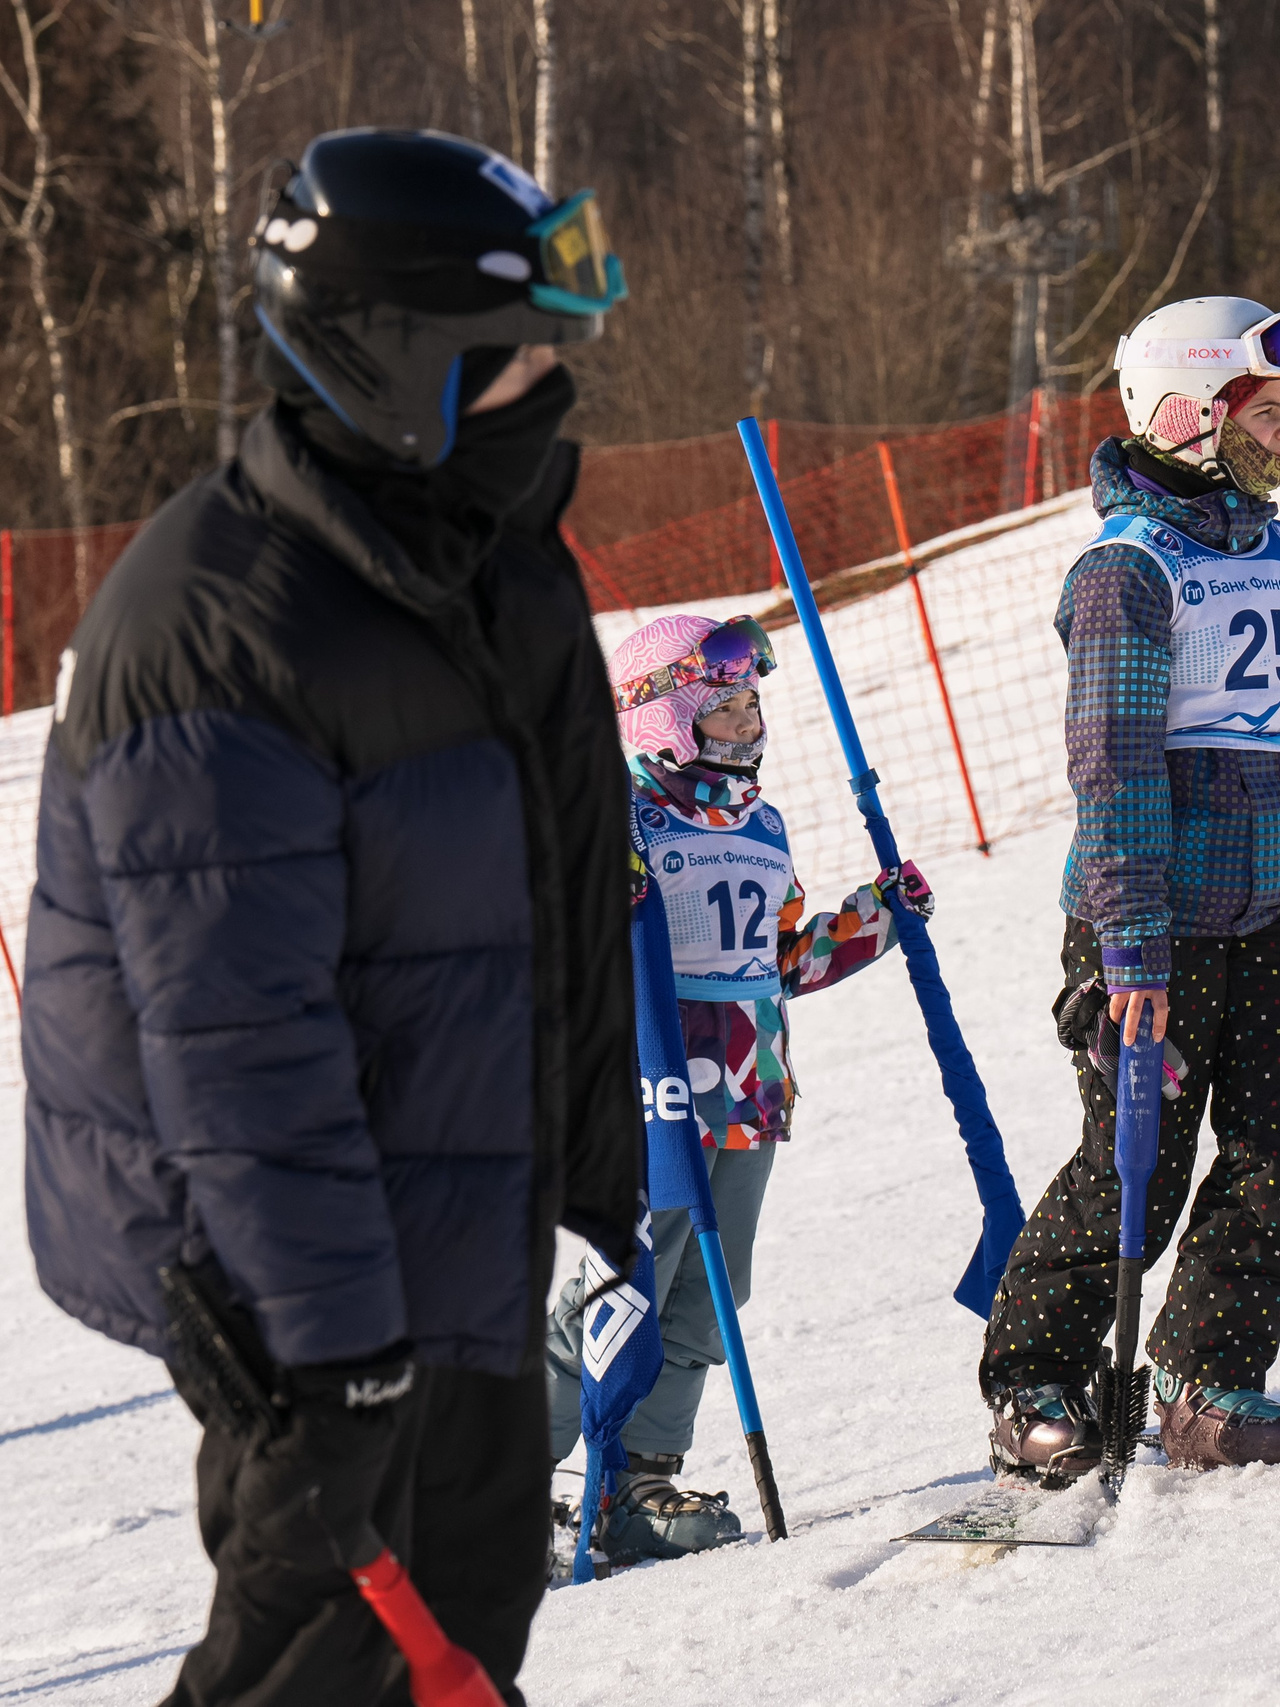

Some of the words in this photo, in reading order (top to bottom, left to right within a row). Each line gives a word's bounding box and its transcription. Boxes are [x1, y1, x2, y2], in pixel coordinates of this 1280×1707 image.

[1188, 348, 1233, 359] ROXY
[1208, 579, 1250, 596] Банк
[629, 804, 648, 853] RUSSIAN
[688, 852, 722, 867] Банк
[723, 850, 787, 875] Финсервис
[706, 879, 768, 951] 12
